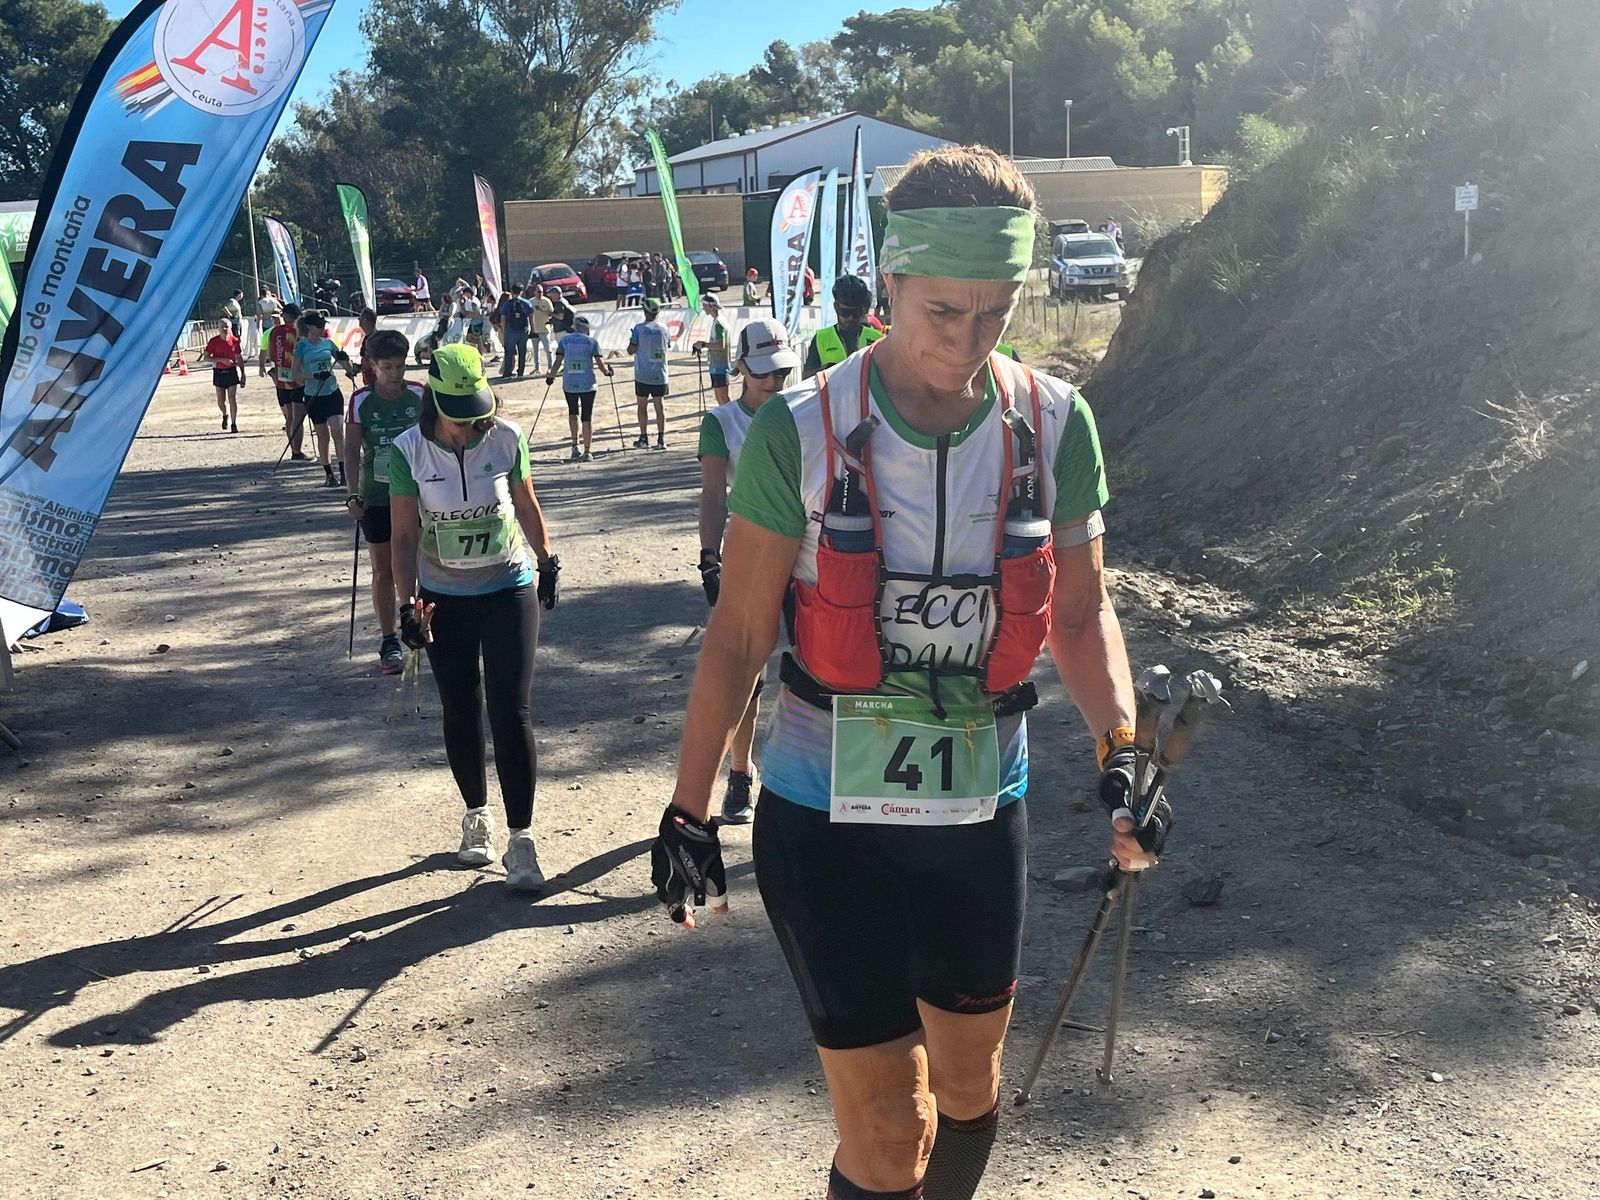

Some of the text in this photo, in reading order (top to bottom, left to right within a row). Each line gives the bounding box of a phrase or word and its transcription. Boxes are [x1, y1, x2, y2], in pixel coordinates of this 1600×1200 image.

[252, 7, 269, 74] nyera
[191, 89, 223, 108] Ceuta
[11, 194, 92, 381] club de montaña
[11, 140, 204, 472] ANYERA
[458, 532, 491, 556] 77
[881, 588, 990, 630] ECCI
[855, 701, 893, 709] MARCHA
[884, 736, 953, 791] 41
[881, 803, 921, 816] Cámara
